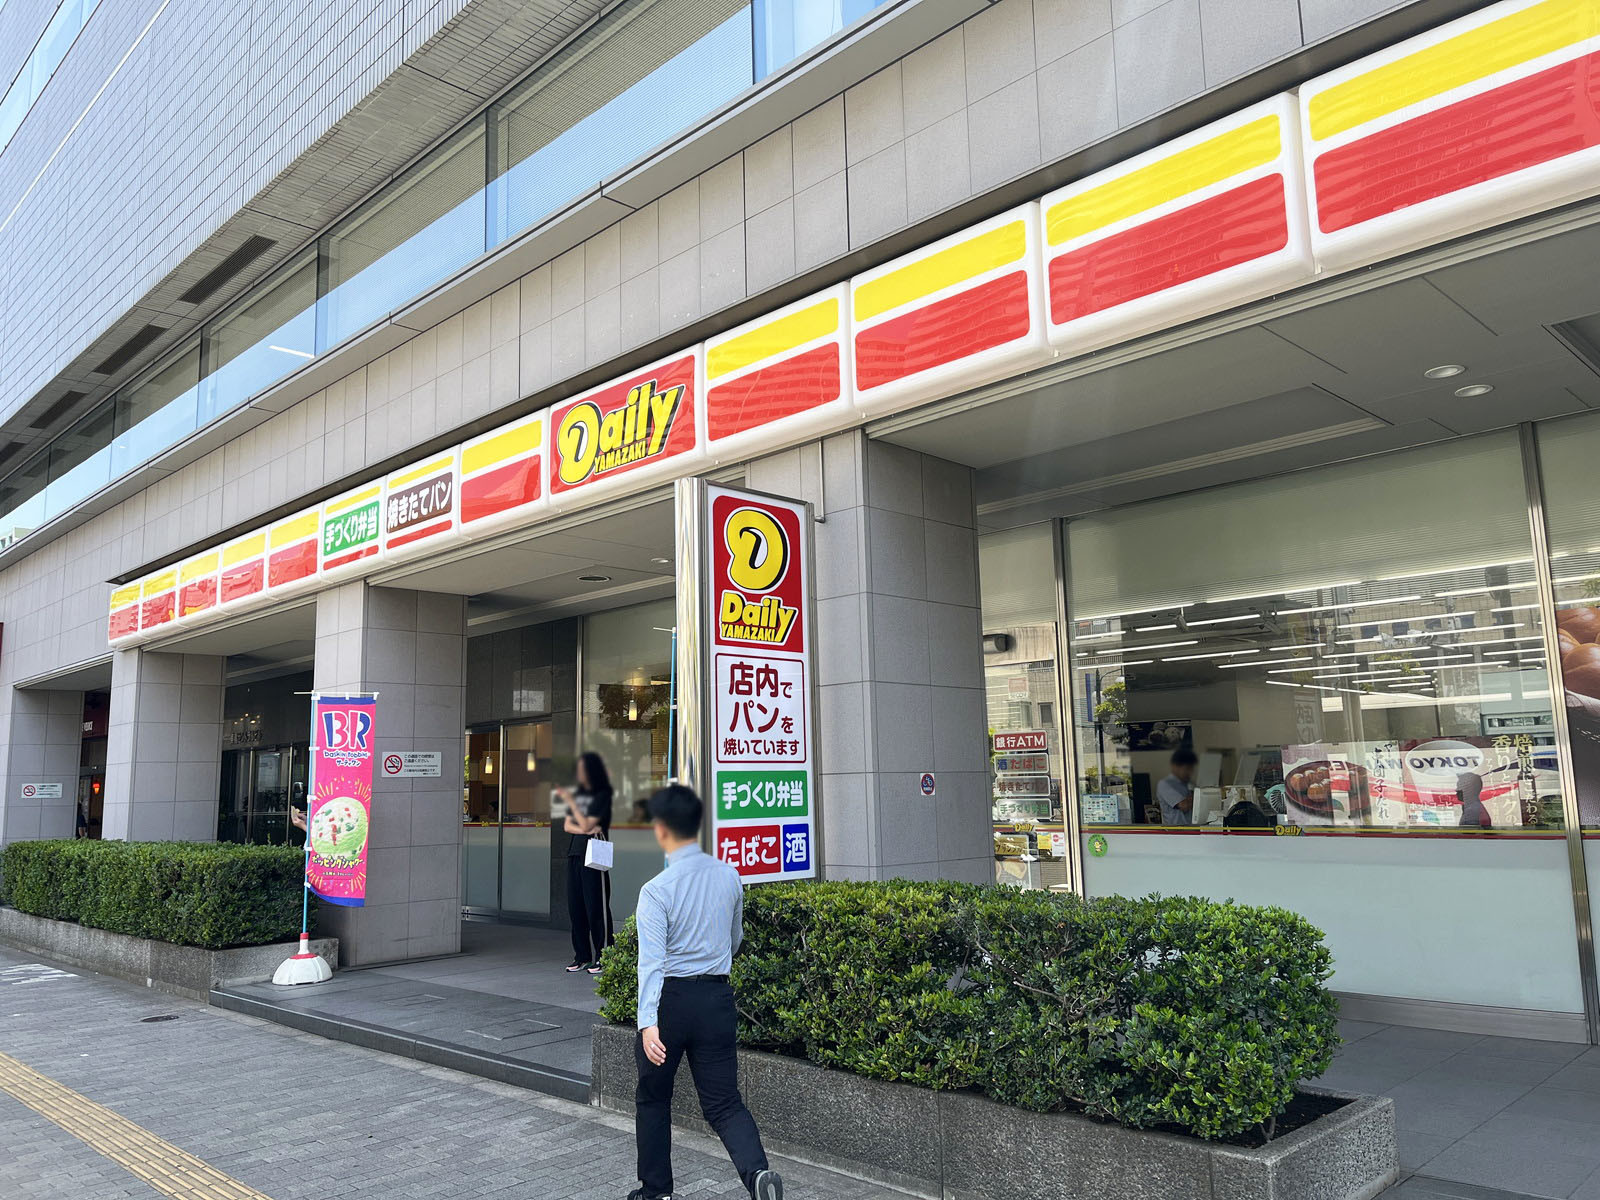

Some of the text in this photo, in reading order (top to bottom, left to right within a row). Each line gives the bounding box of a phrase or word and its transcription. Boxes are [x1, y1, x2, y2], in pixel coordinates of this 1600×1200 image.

[558, 380, 684, 483] Daily
[595, 440, 646, 473] YAMAZAKI
[387, 481, 451, 529] 焼きたてパン
[325, 506, 378, 551] 手づくり弁当
[721, 592, 796, 642] Daily
[721, 623, 775, 642] YAMAZAKI
[729, 661, 792, 698] 店内で
[322, 710, 372, 749] BR
[729, 700, 794, 733] パンを
[723, 738, 799, 756] 焼いています
[995, 735, 1045, 748] 銀行ATM
[997, 757, 1046, 771] 酒 たばこ
[722, 780, 804, 810] 手づくり弁当
[1014, 823, 1034, 833] Daily
[1275, 825, 1302, 836] Daily
[720, 832, 807, 867] たばこ 酒
